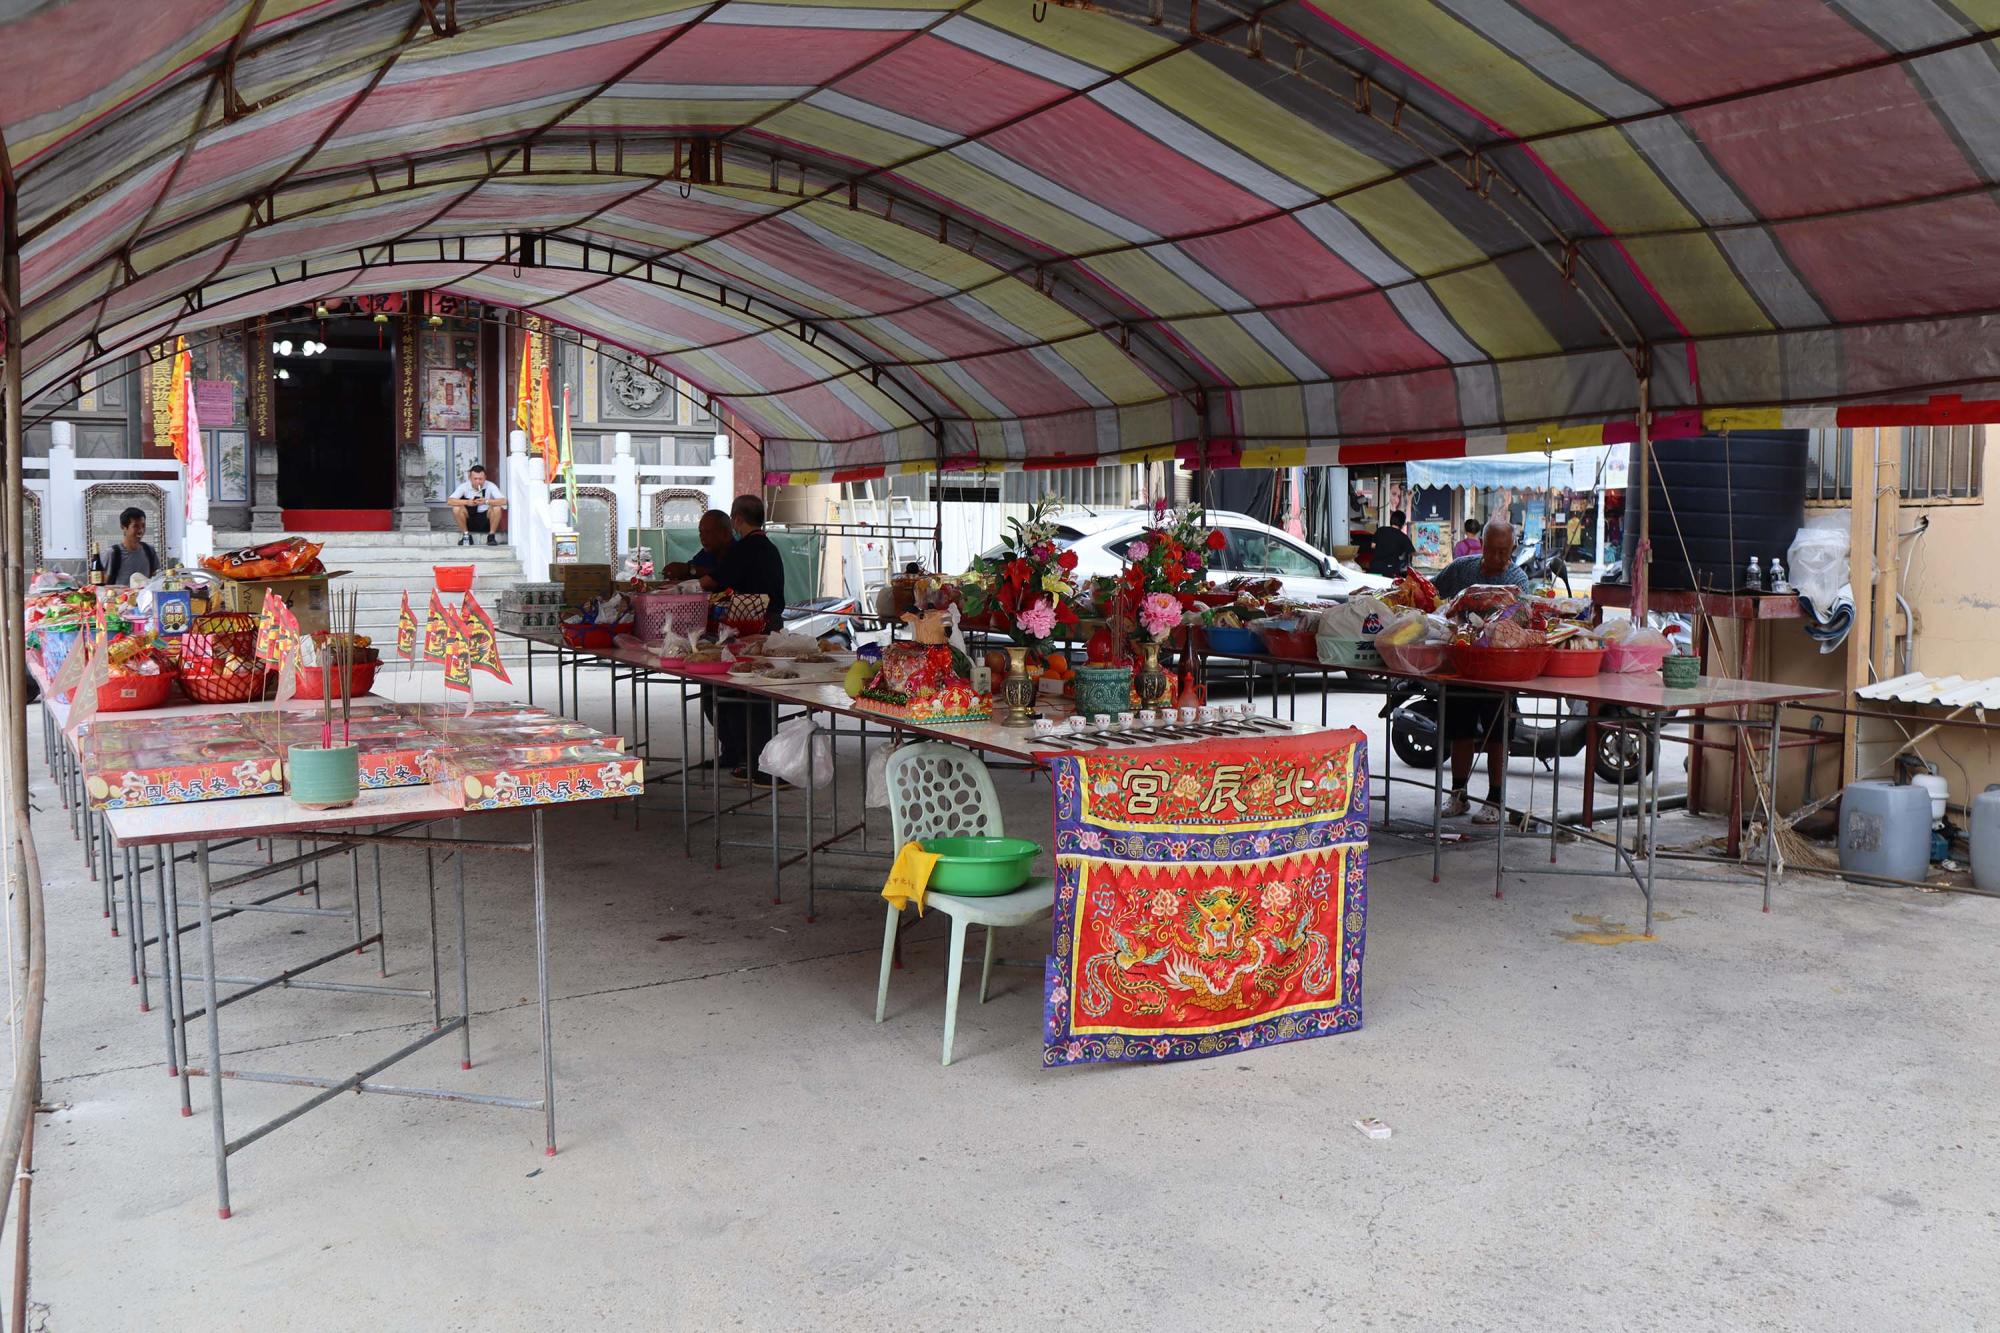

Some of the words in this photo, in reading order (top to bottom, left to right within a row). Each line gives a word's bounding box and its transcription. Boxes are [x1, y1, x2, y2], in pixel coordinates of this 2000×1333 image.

[145, 777, 228, 798] 國泰民安
[516, 778, 593, 799] 國泰民安
